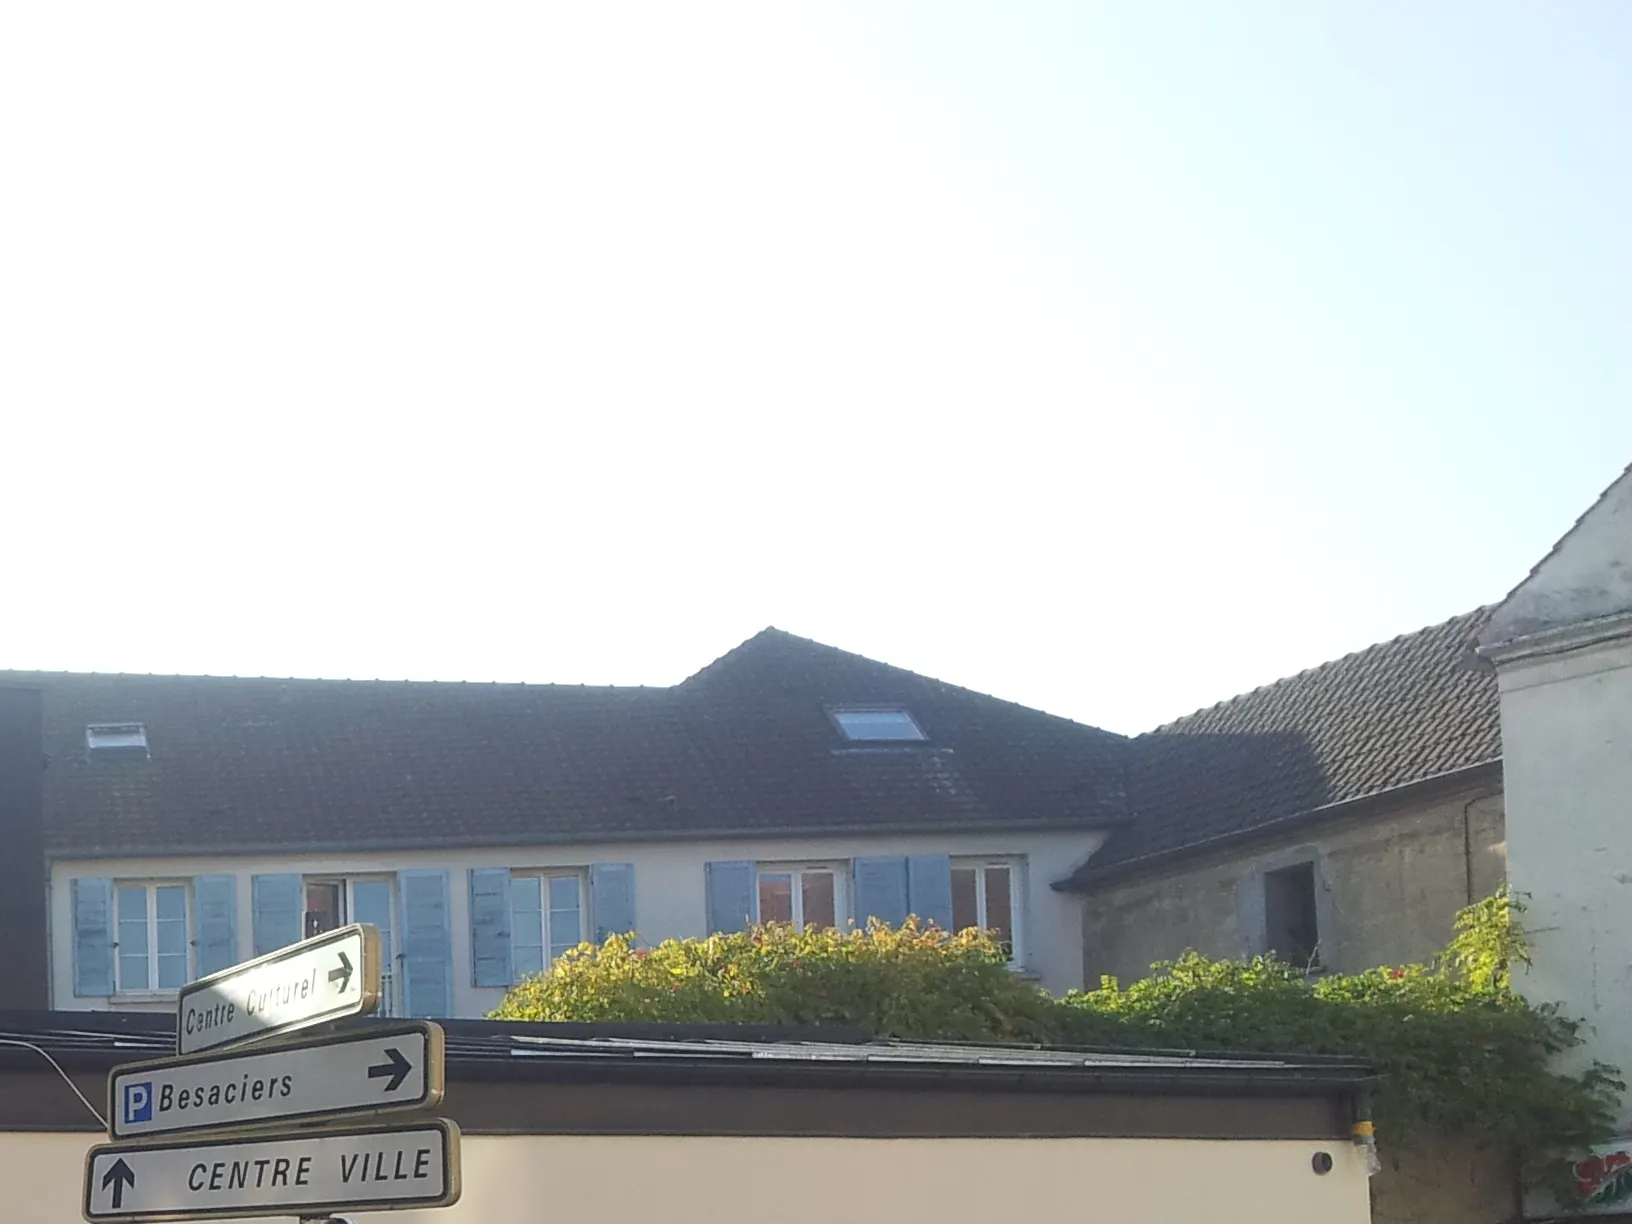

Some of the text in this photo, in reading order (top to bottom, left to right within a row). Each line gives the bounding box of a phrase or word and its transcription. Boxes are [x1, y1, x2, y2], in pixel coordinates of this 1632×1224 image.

[185, 1001, 235, 1036] Centre
[158, 1073, 293, 1113] Besaciers
[188, 1148, 431, 1192] CENTRE VILLE
